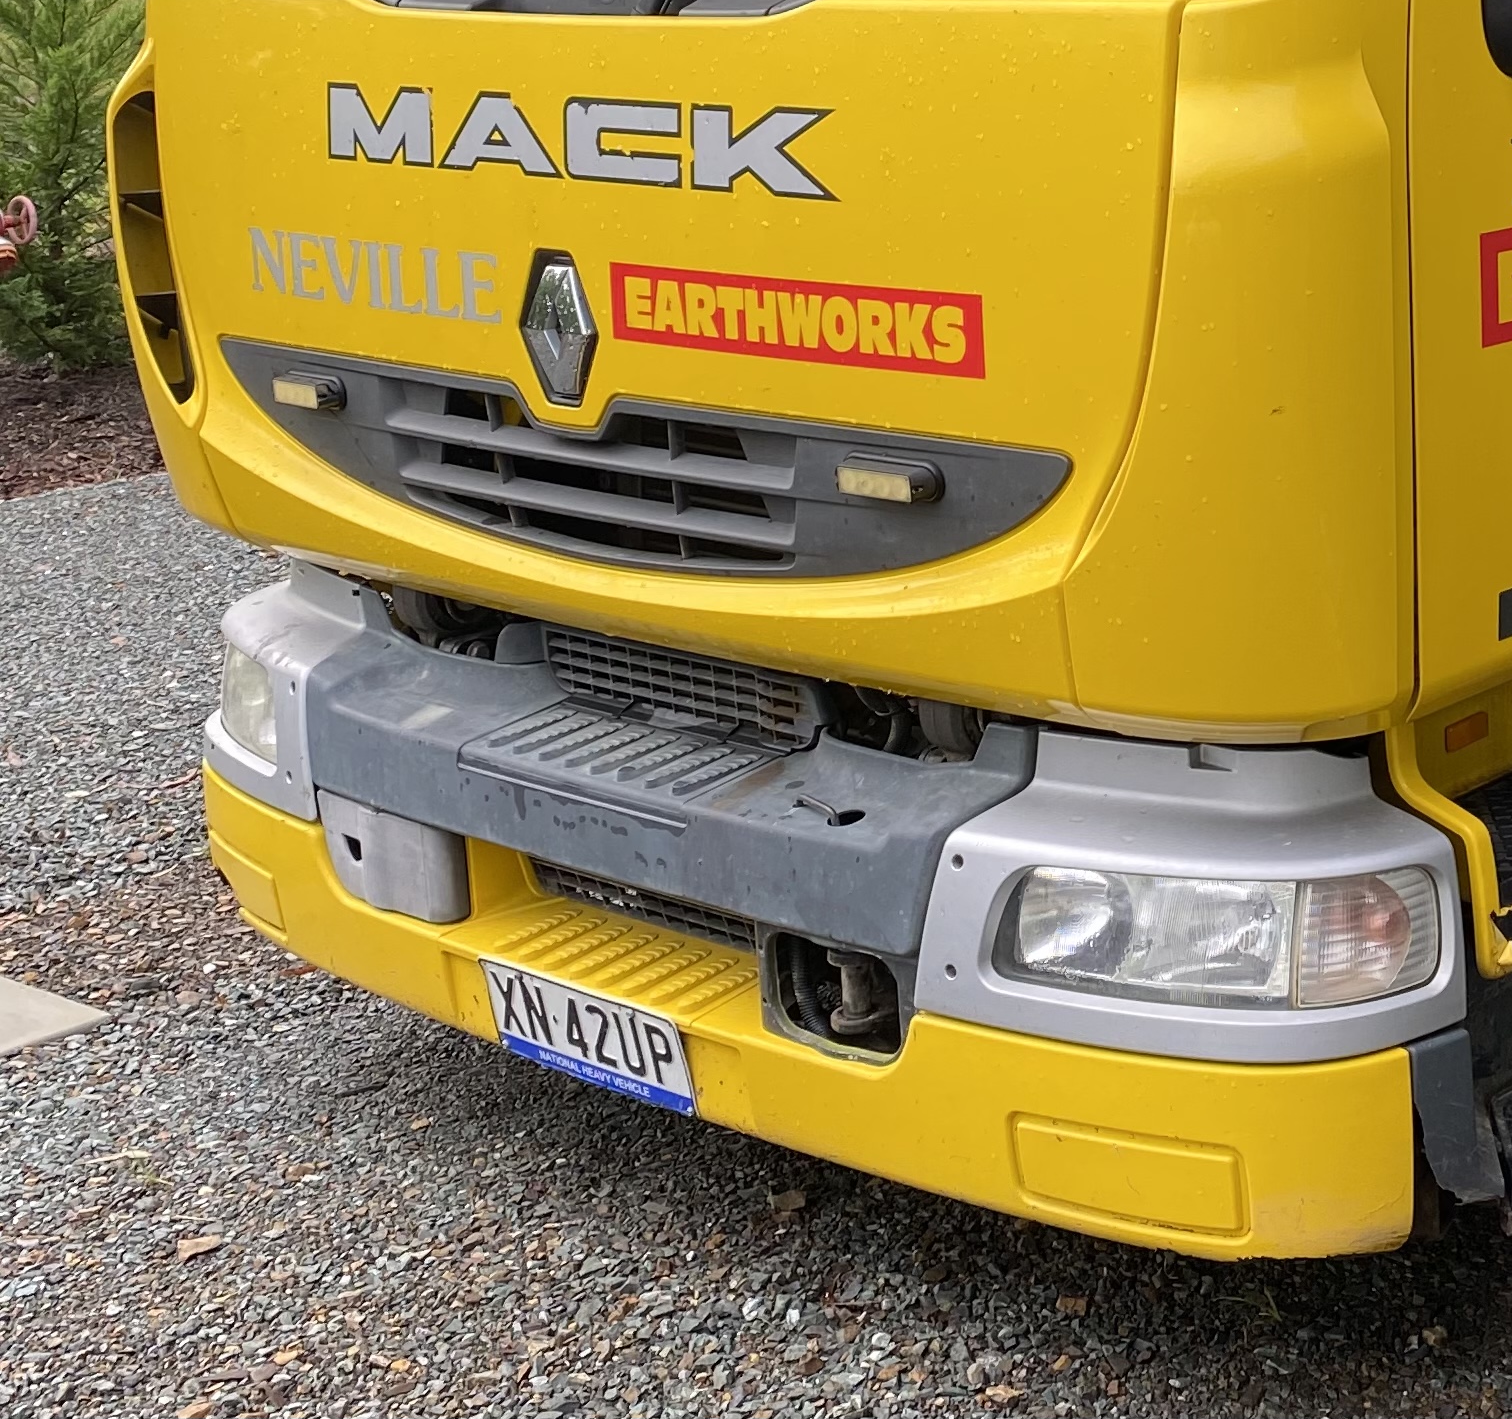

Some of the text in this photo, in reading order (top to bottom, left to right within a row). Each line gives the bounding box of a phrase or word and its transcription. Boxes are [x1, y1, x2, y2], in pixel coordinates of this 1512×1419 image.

[326, 81, 843, 202] MACK
[248, 226, 502, 324] NEVILLE
[623, 276, 967, 365] EARTHWORKS
[538, 1049, 651, 1097] NATIONAL HEAVY VEHICLE
